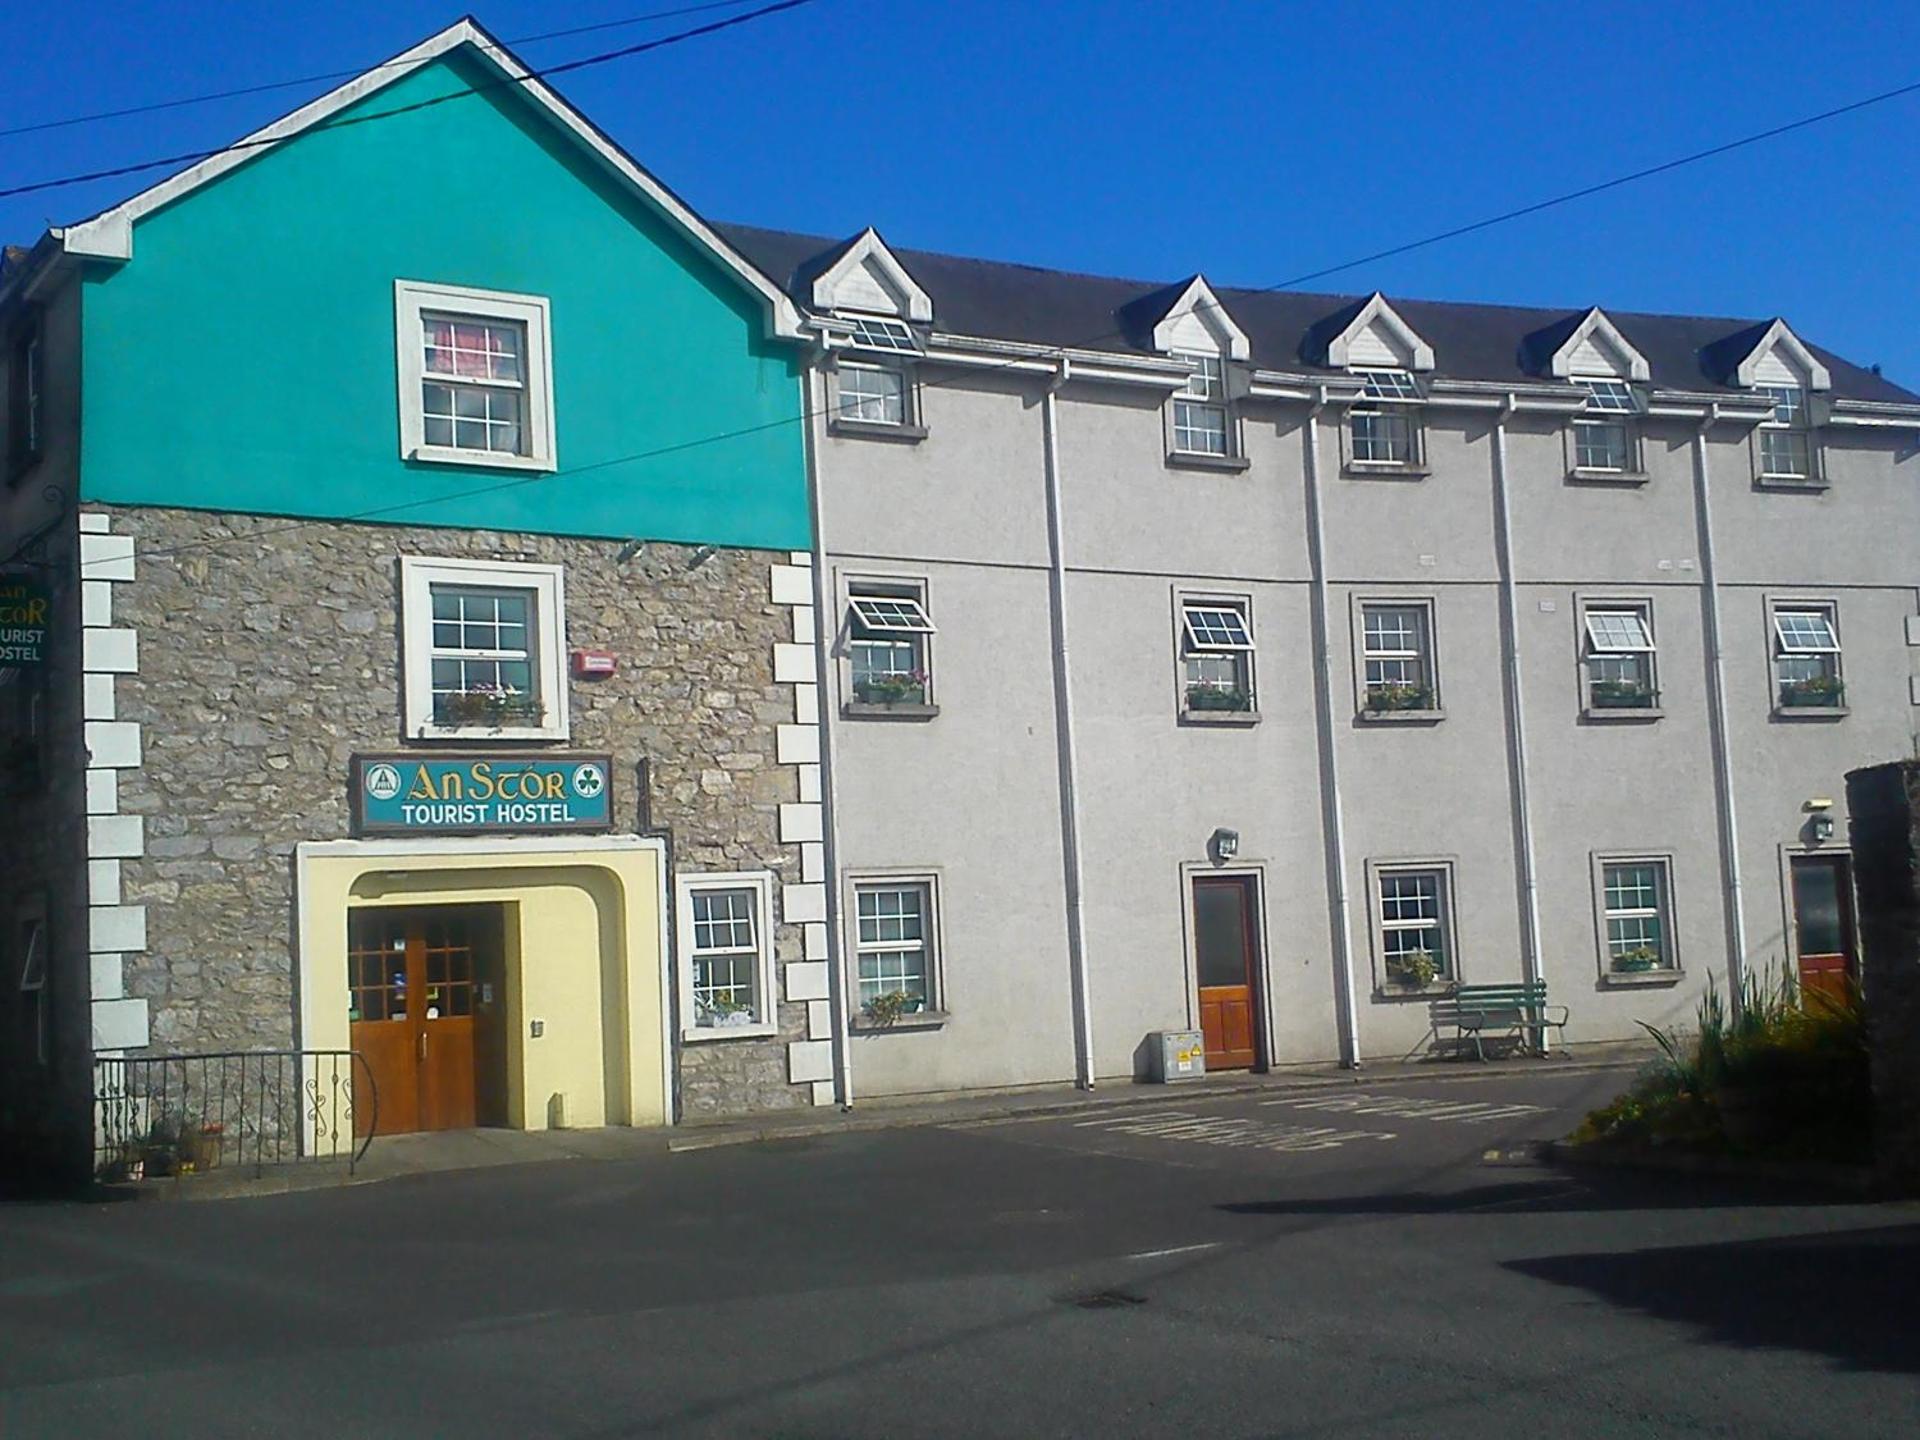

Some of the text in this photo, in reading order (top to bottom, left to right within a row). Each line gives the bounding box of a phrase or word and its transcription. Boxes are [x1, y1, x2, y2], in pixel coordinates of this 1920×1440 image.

[0, 628, 45, 644] URIST
[0, 645, 41, 661] OSTEL
[402, 803, 575, 824] TOURIST HOSTEL
